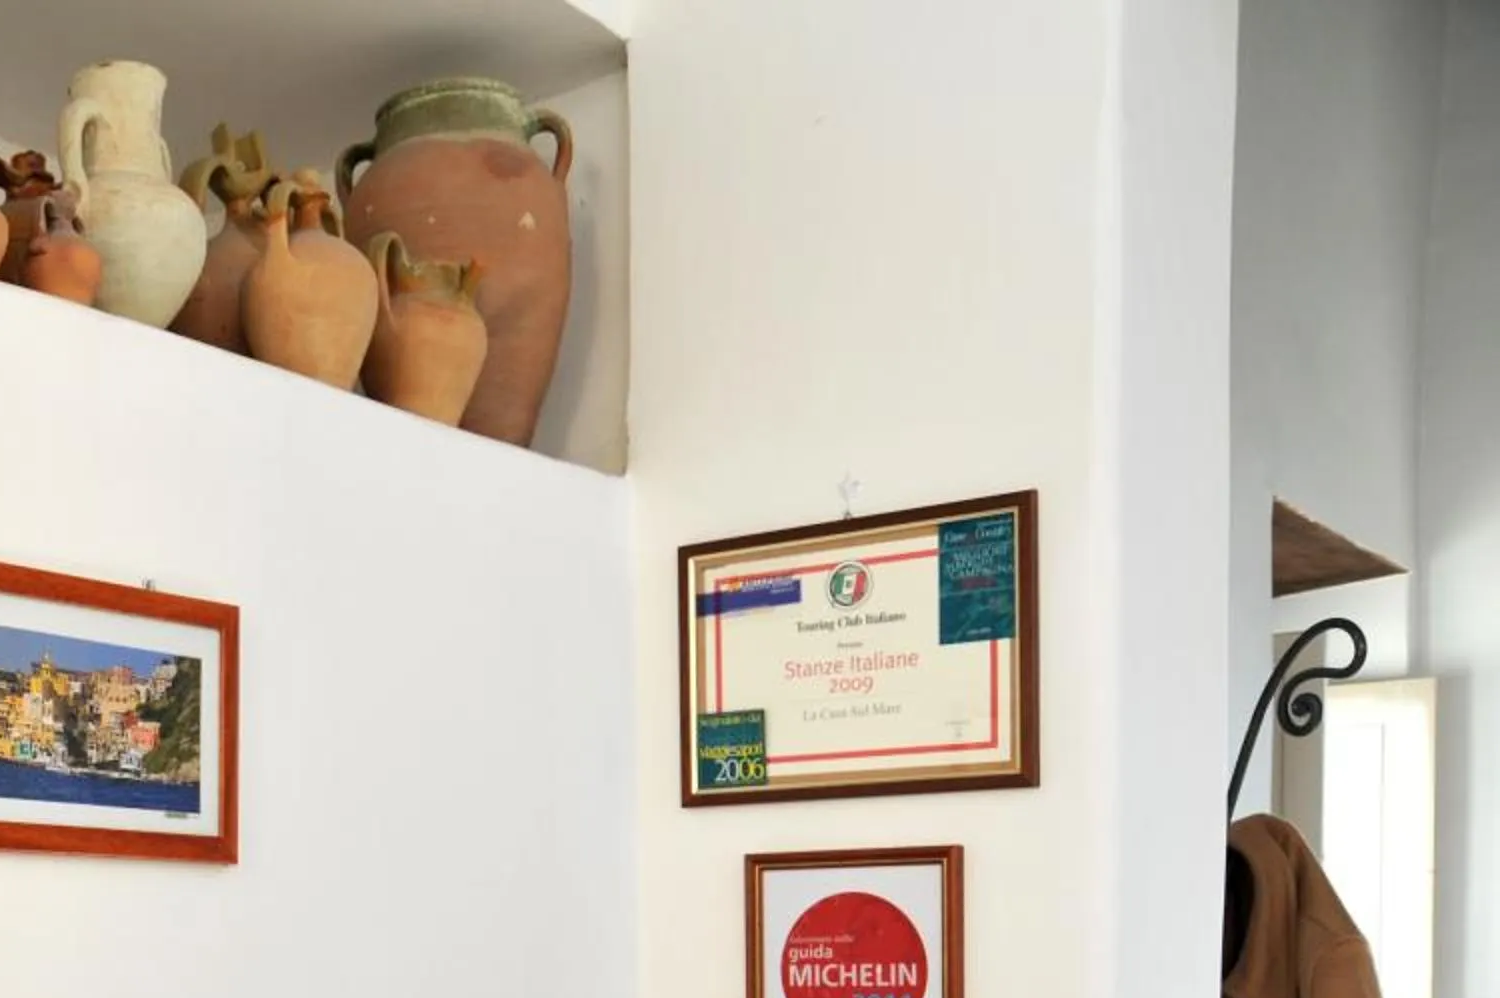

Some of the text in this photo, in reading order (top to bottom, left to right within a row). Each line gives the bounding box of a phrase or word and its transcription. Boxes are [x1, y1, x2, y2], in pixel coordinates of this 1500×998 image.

[784, 648, 921, 681] Stanze Italiane
[828, 674, 875, 695] 2009
[713, 754, 765, 785] 2006
[788, 944, 834, 963] guida
[788, 962, 918, 987] MICHELIN
